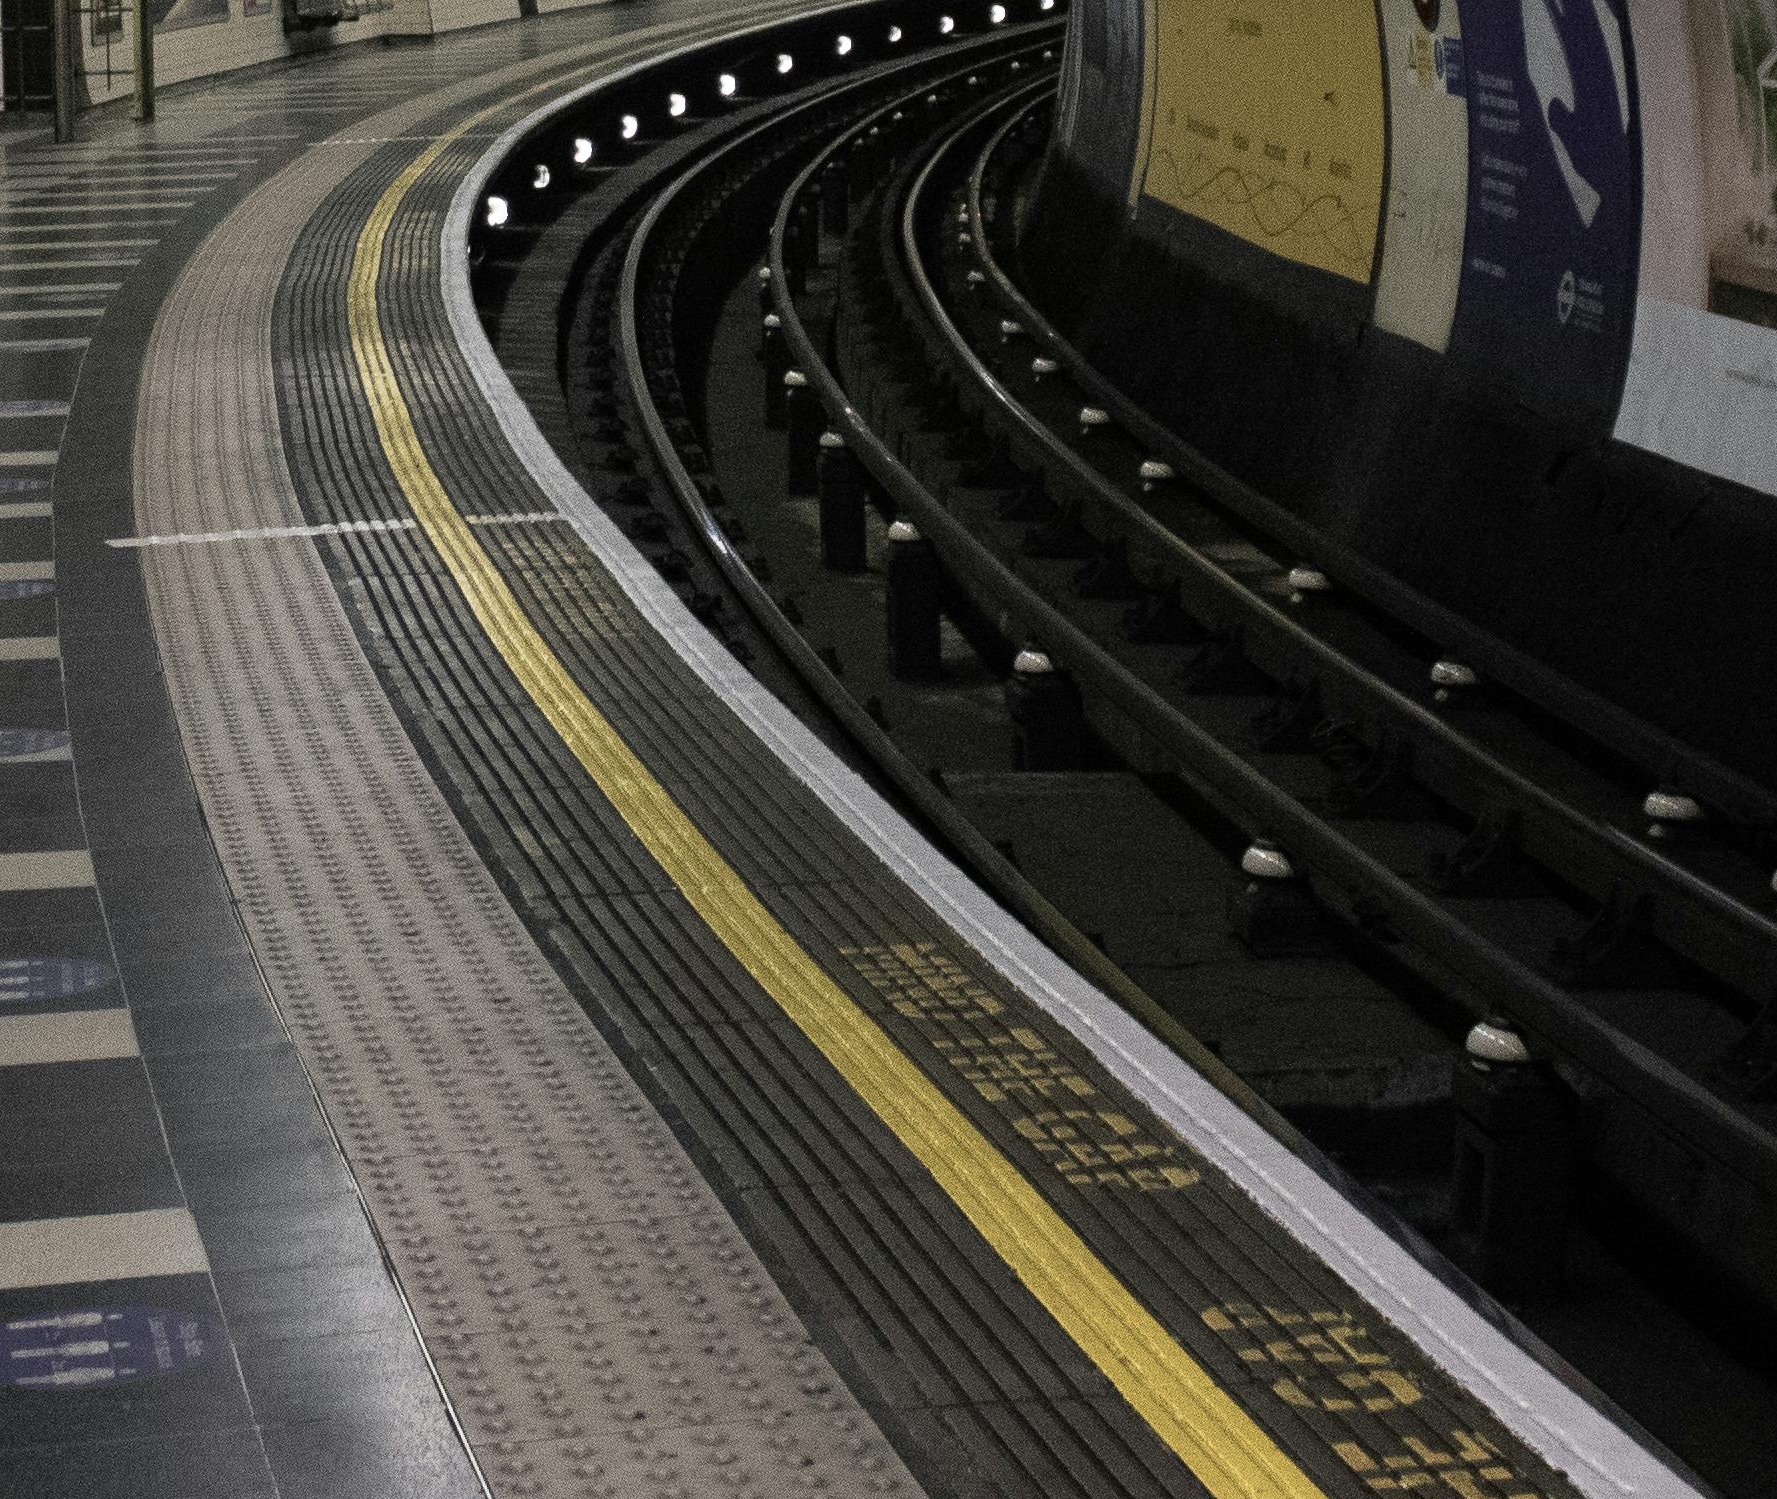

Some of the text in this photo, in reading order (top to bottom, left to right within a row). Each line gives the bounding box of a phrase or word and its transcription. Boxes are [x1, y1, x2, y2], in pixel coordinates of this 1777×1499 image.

[838, 941, 1202, 1193] MIND THE GAP
